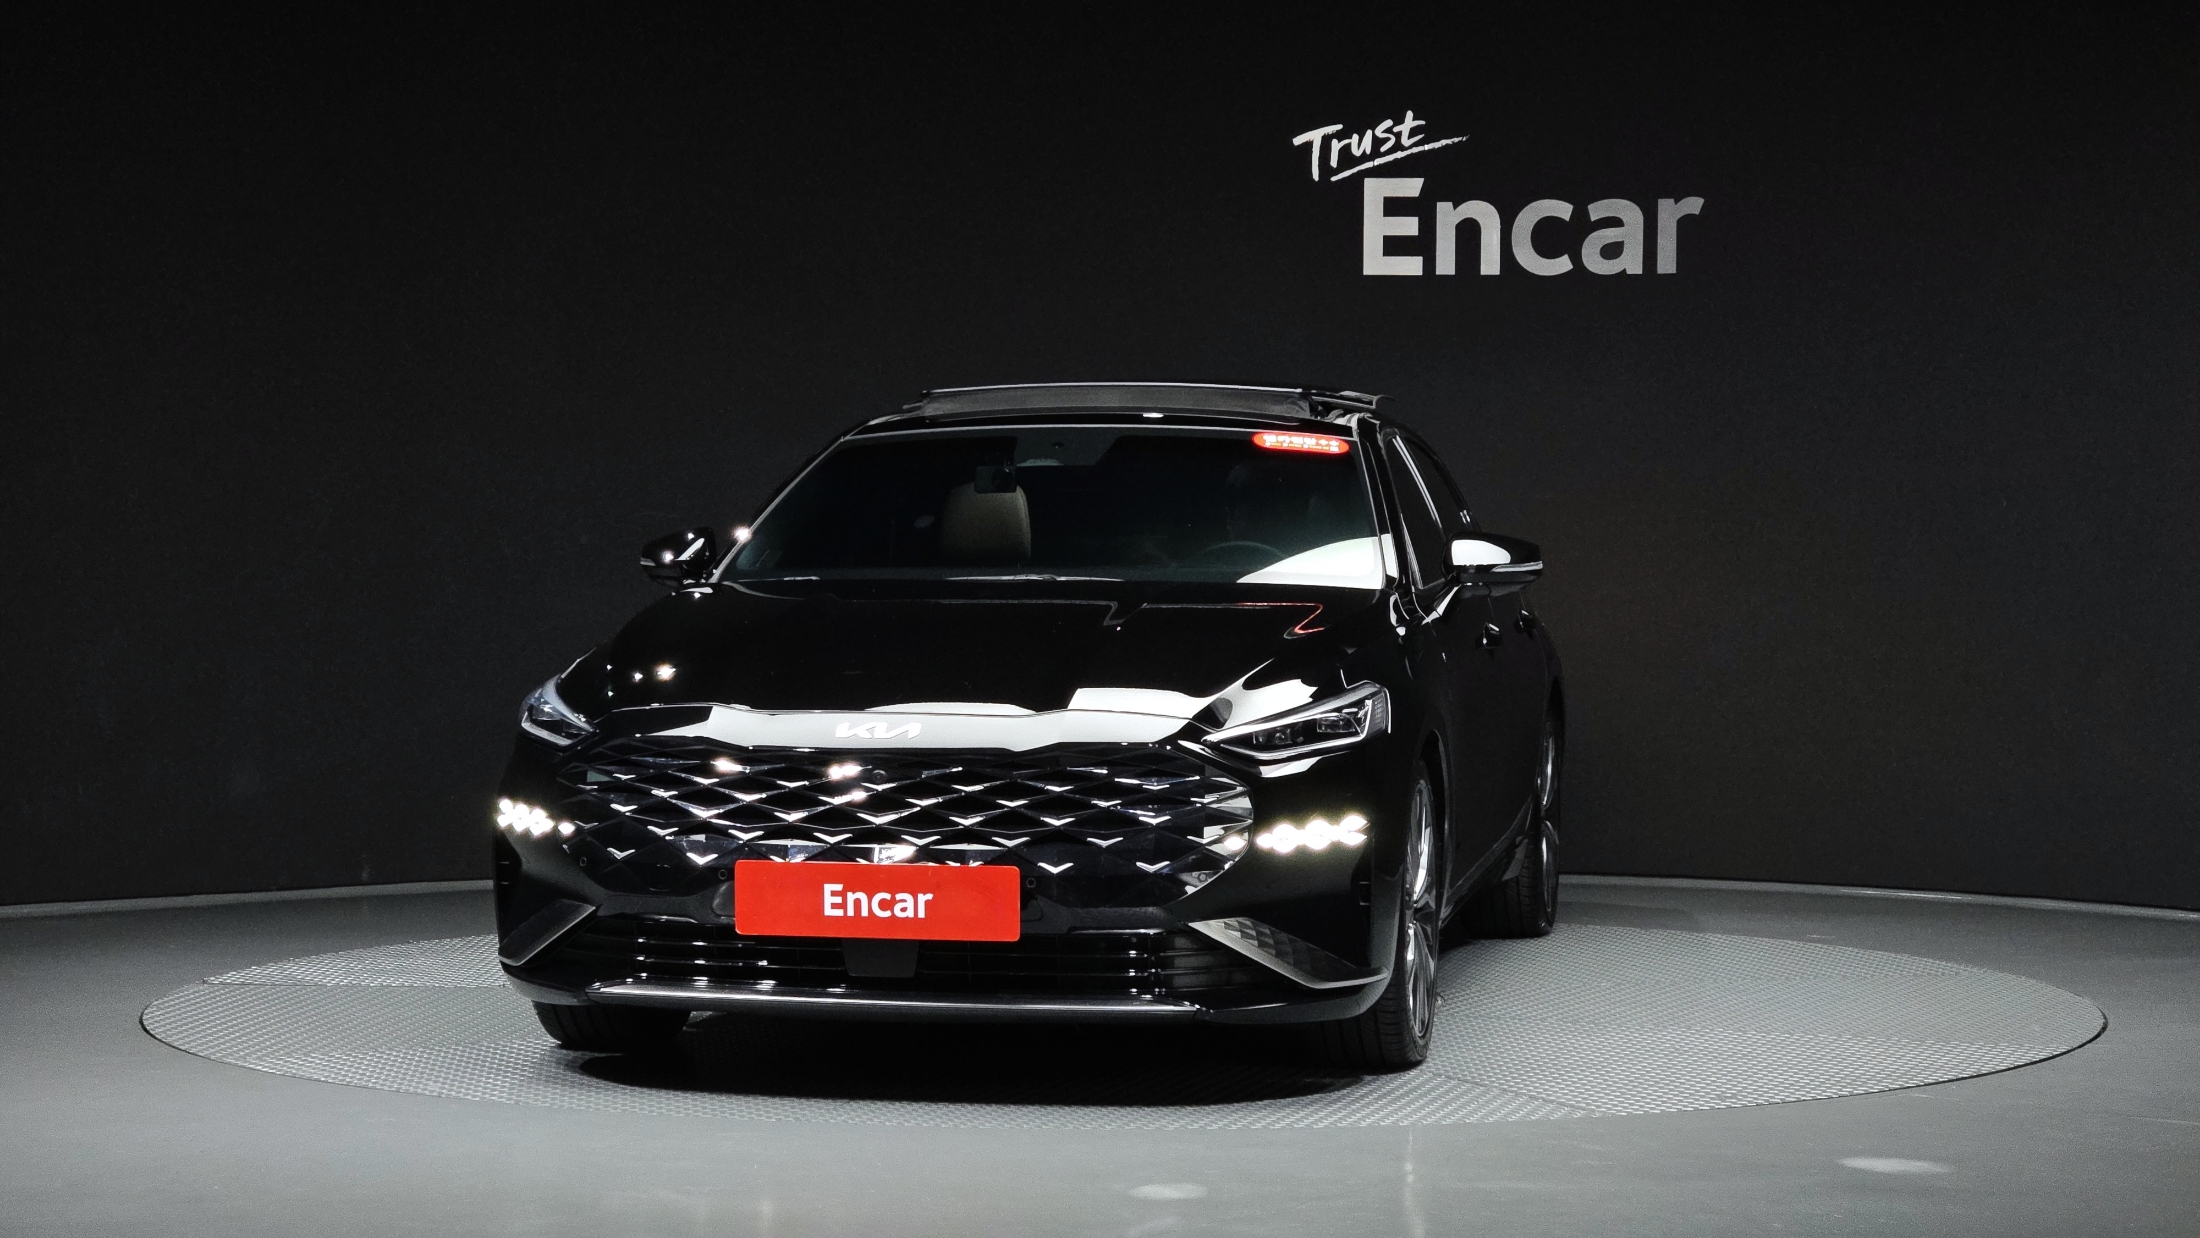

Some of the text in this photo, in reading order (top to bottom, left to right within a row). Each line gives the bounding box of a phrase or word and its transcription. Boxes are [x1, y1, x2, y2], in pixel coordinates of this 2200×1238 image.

[1292, 109, 1427, 182] Trust
[1362, 177, 1705, 277] Encar
[822, 883, 934, 919] Encar
